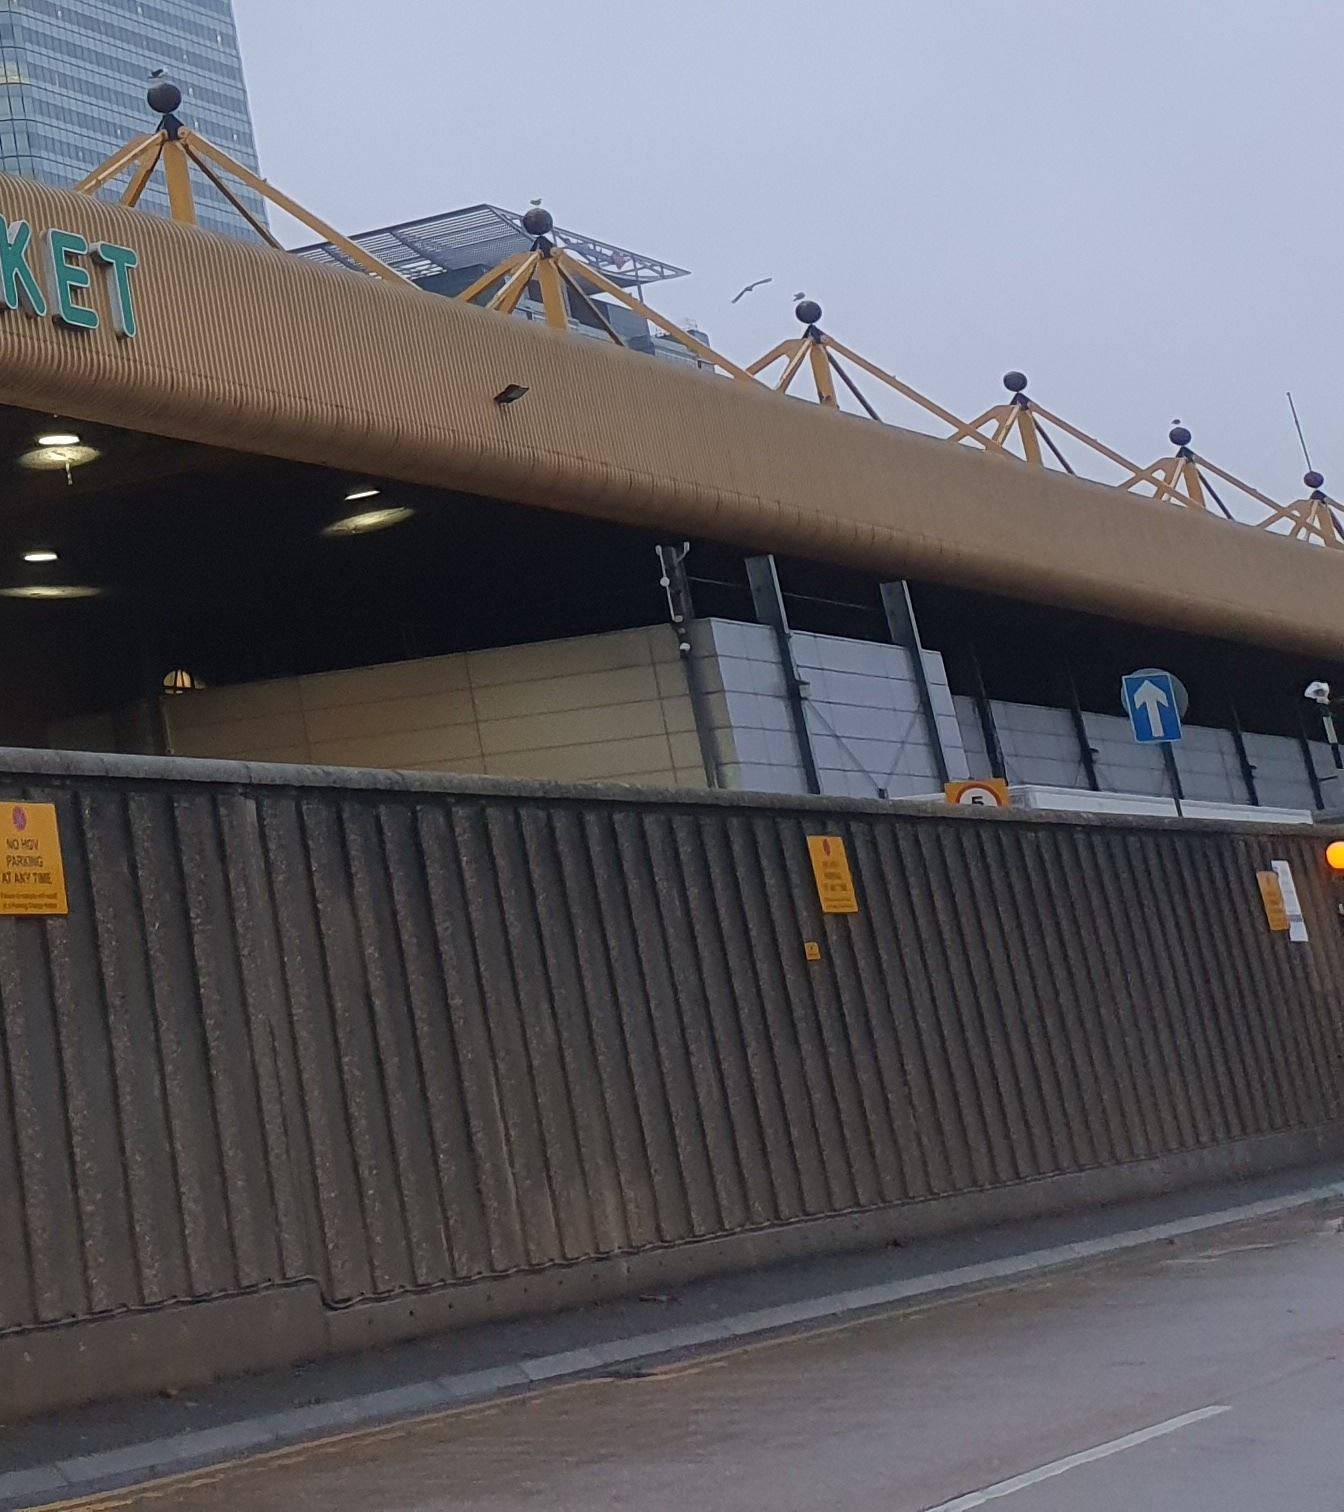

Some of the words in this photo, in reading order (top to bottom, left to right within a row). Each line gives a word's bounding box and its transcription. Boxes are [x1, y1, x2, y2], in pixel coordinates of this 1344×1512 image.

[6, 838, 19, 850] NO
[6, 855, 43, 868] PARKING
[1, 871, 11, 884] AT
